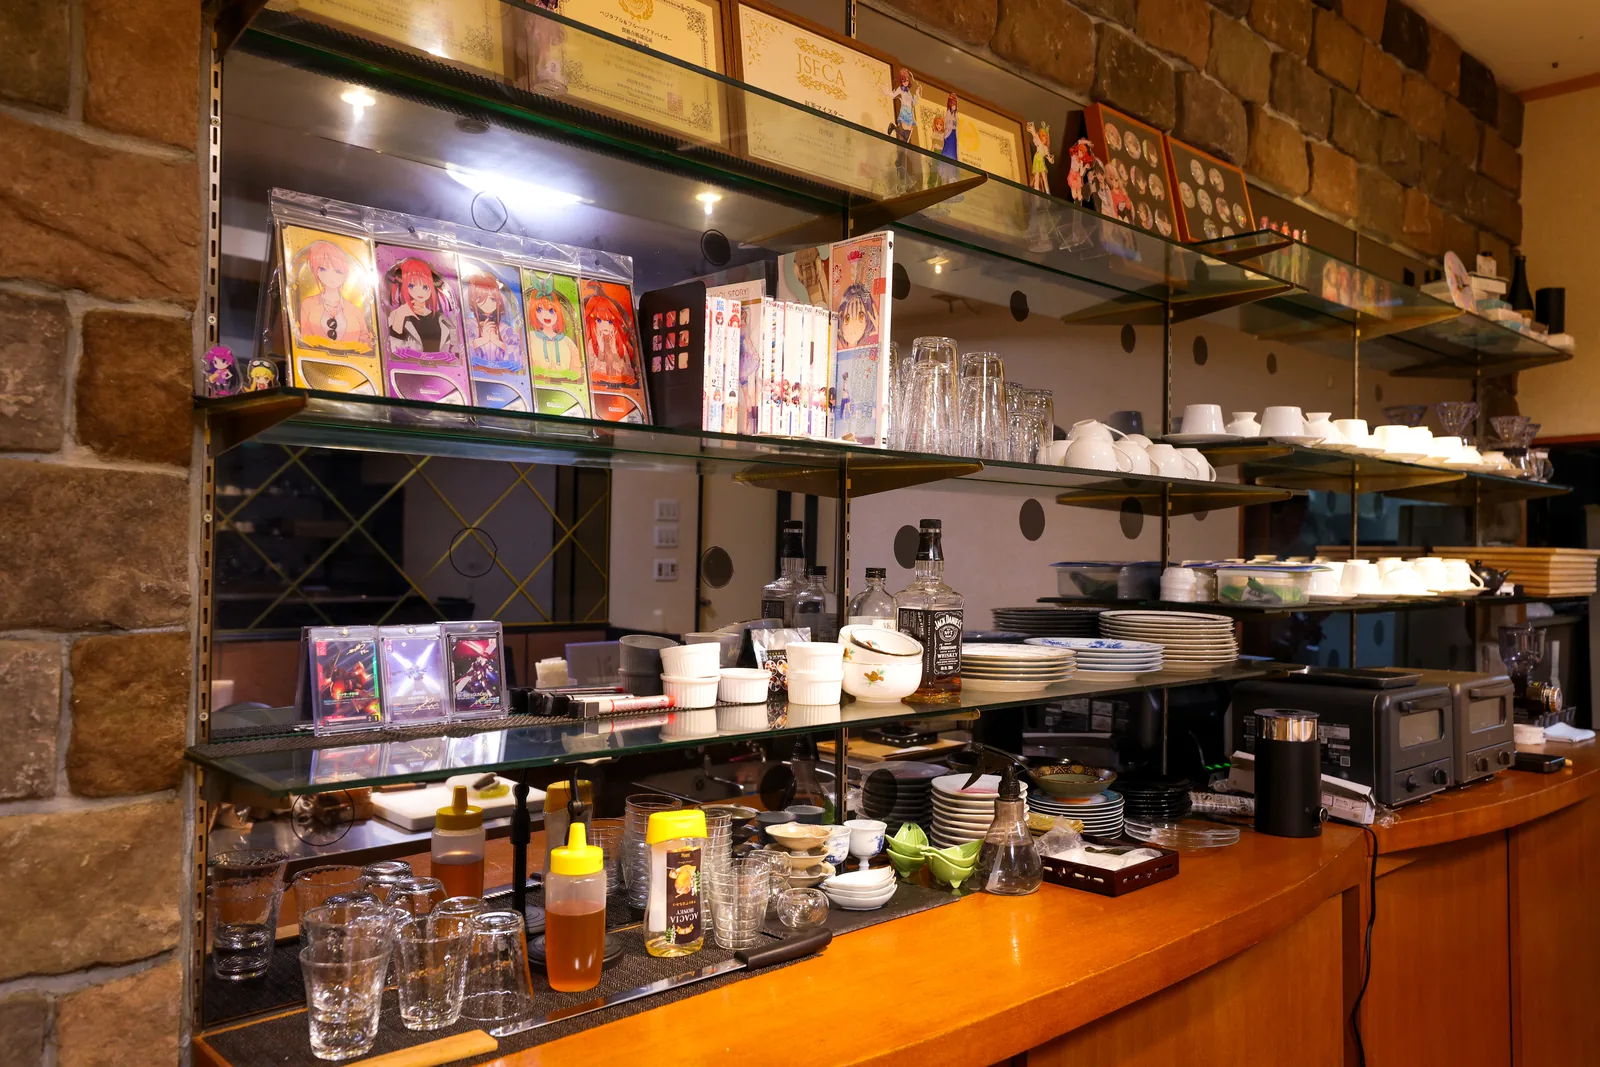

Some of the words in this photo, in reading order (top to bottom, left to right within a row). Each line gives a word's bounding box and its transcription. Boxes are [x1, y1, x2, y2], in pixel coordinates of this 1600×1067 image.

[796, 53, 846, 87] JSFCA
[934, 616, 946, 631] JACK
[670, 912, 699, 924] ACACIA
